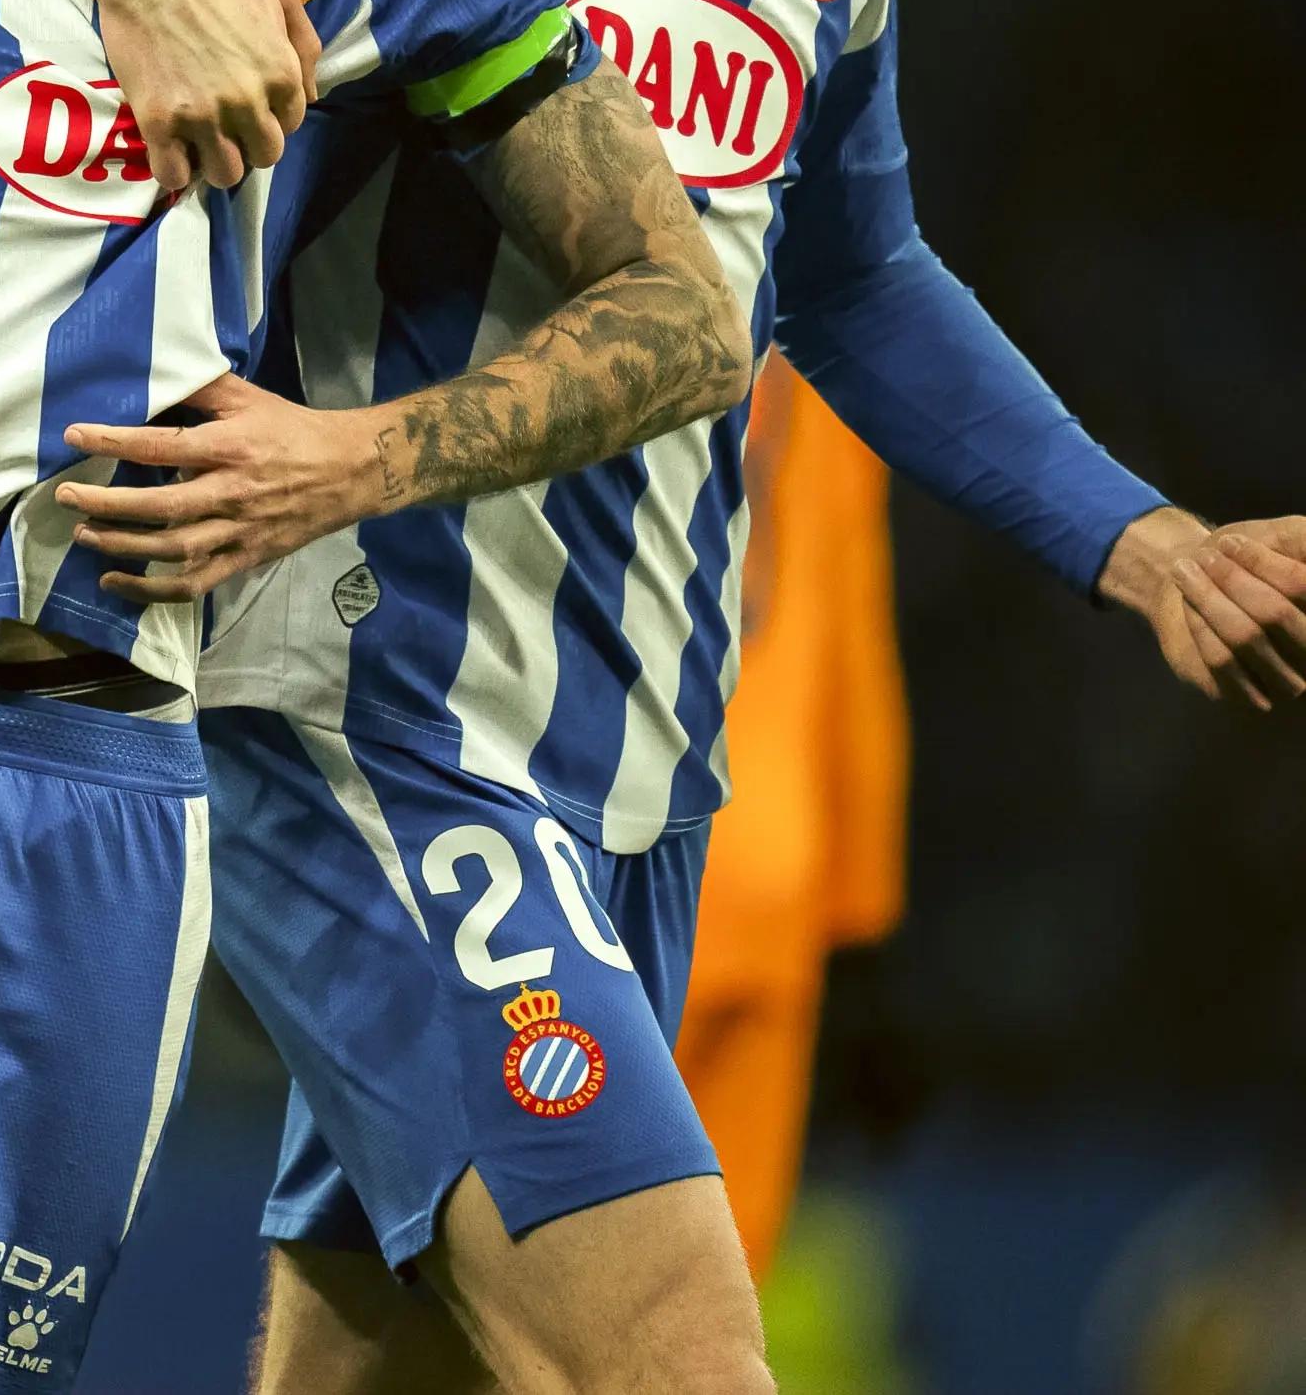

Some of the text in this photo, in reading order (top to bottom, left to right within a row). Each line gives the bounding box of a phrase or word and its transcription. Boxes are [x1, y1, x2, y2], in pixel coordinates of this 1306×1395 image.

[13, 80, 154, 182] DA
[584, 5, 774, 156] DANI
[421, 816, 634, 991] 20
[506, 1023, 595, 1077] RCD ESPANYOL
[513, 1060, 603, 1115] DE BARCELONA
